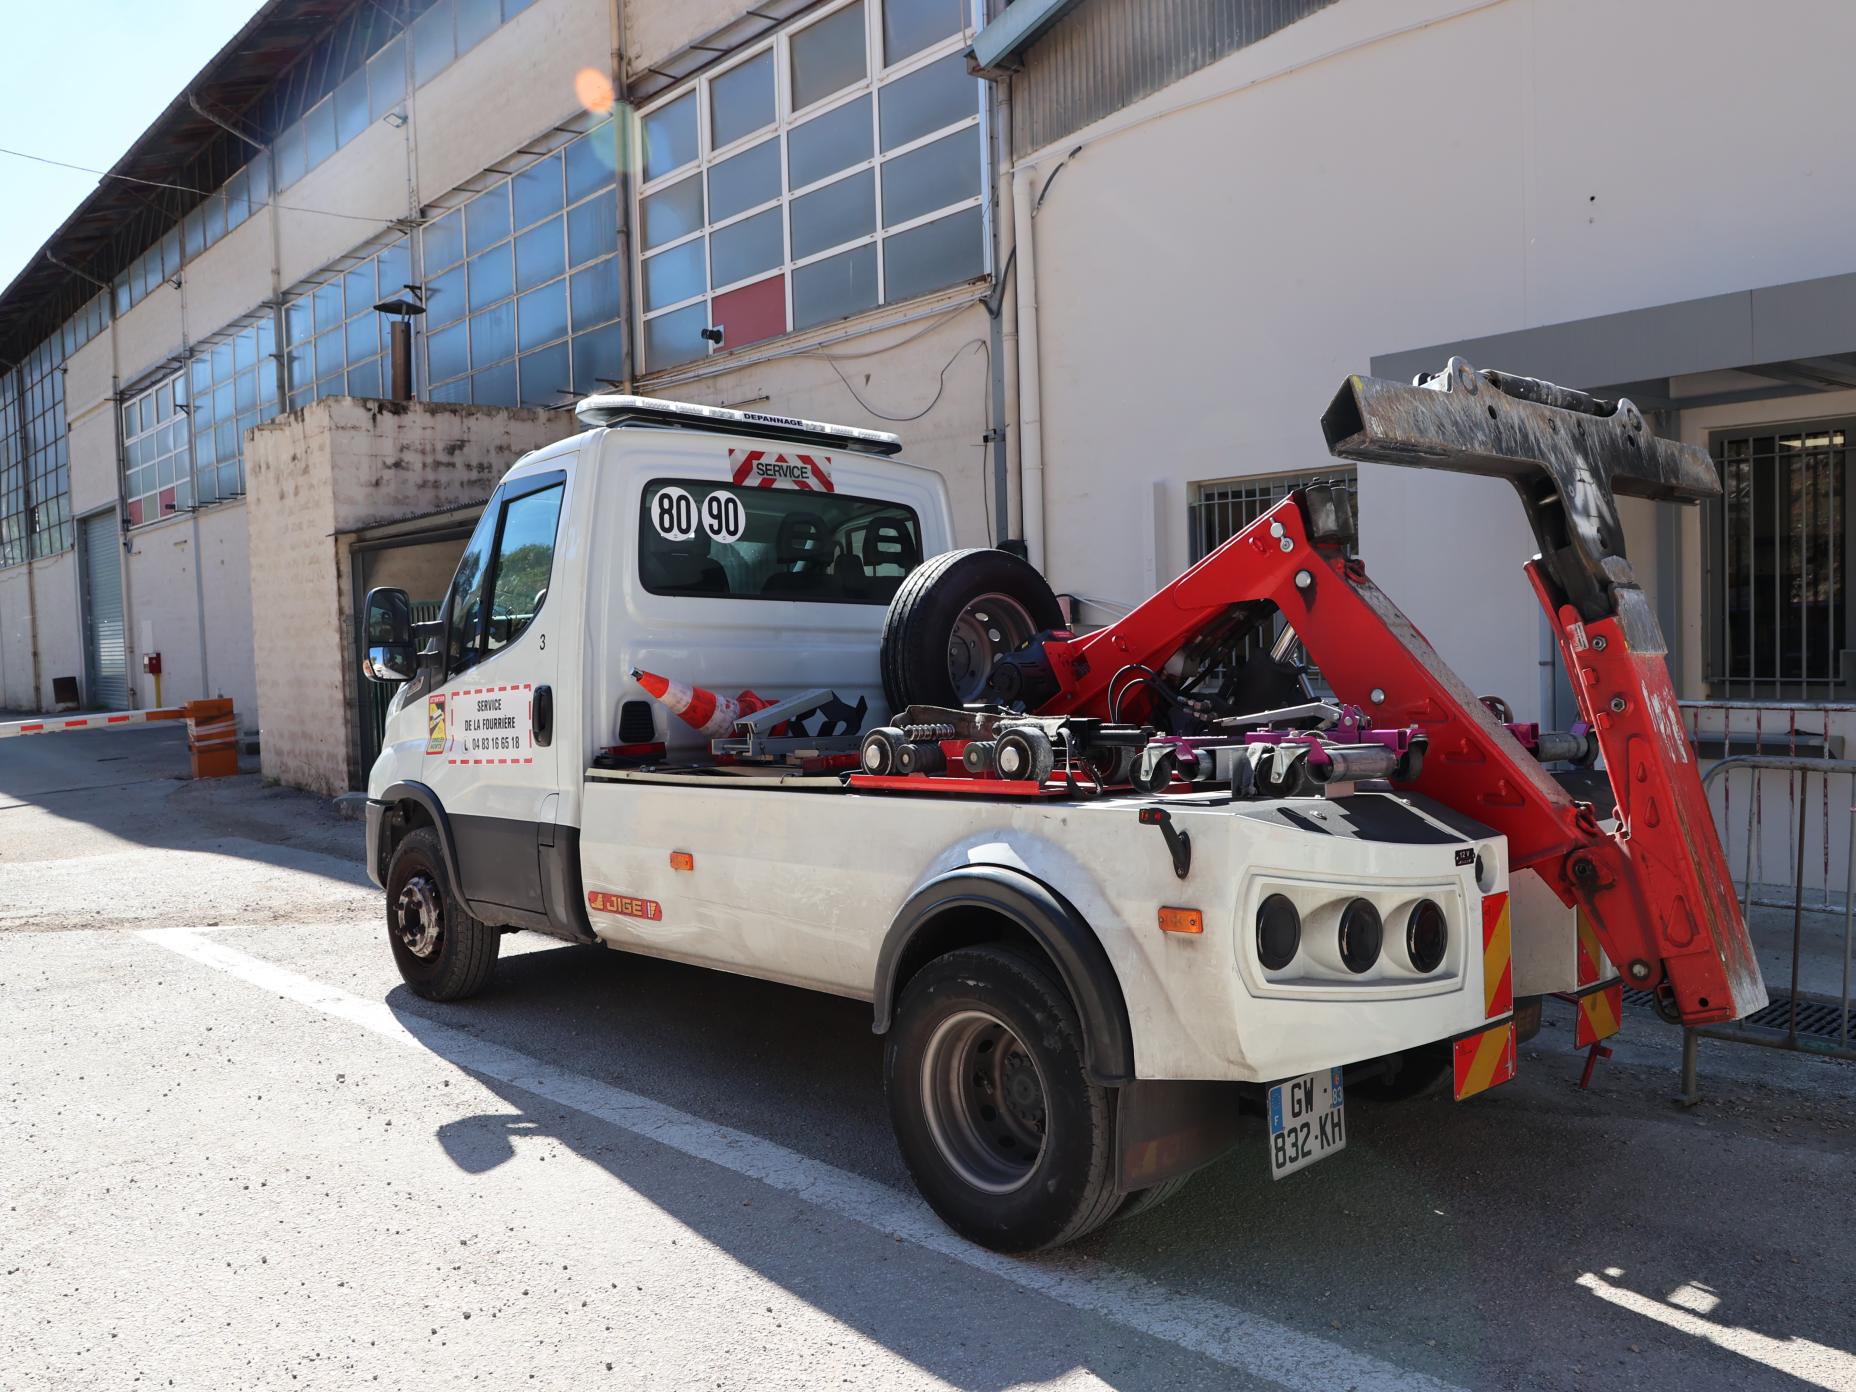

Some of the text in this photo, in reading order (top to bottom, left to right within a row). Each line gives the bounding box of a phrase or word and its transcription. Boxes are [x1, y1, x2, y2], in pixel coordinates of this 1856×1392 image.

[743, 412, 803, 427] DEPANNAGE
[756, 462, 809, 479] SERVICE
[658, 492, 692, 535] 80
[707, 495, 739, 537] 90
[539, 633, 546, 651] 3
[476, 698, 502, 712] SERVICE
[464, 714, 516, 731] DE LA FOURRIÈRE
[472, 735, 520, 751] 04 83 16 65 18
[606, 896, 642, 915] JIGE
[1332, 1085, 1343, 1105] 83
[1273, 1115, 1280, 1127] F
